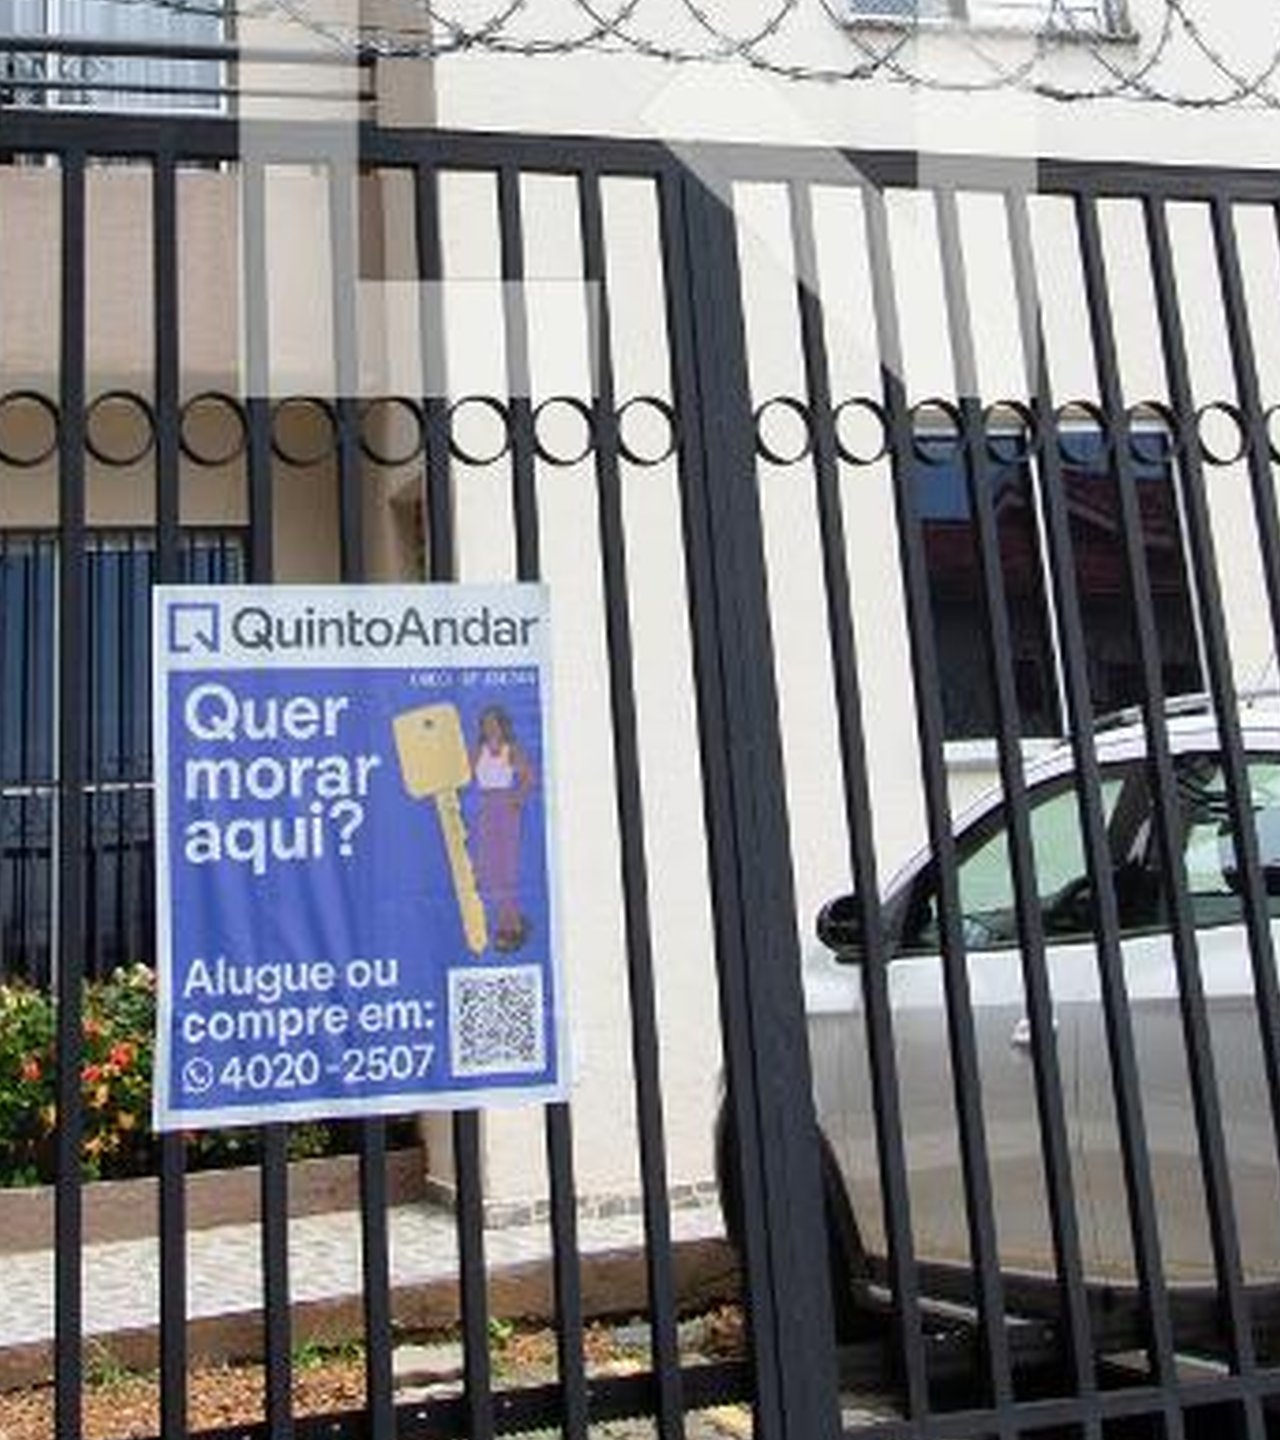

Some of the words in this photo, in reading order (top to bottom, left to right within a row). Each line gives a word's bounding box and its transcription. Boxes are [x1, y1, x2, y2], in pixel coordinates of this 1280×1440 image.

[232, 606, 539, 652] QuintoAndar
[185, 684, 348, 740] Quer
[185, 754, 380, 800] morar
[185, 801, 364, 874] aqui?
[184, 958, 334, 1002] Alugue
[346, 957, 398, 989] ou
[184, 1004, 348, 1046] compre
[360, 1000, 436, 1031] em:
